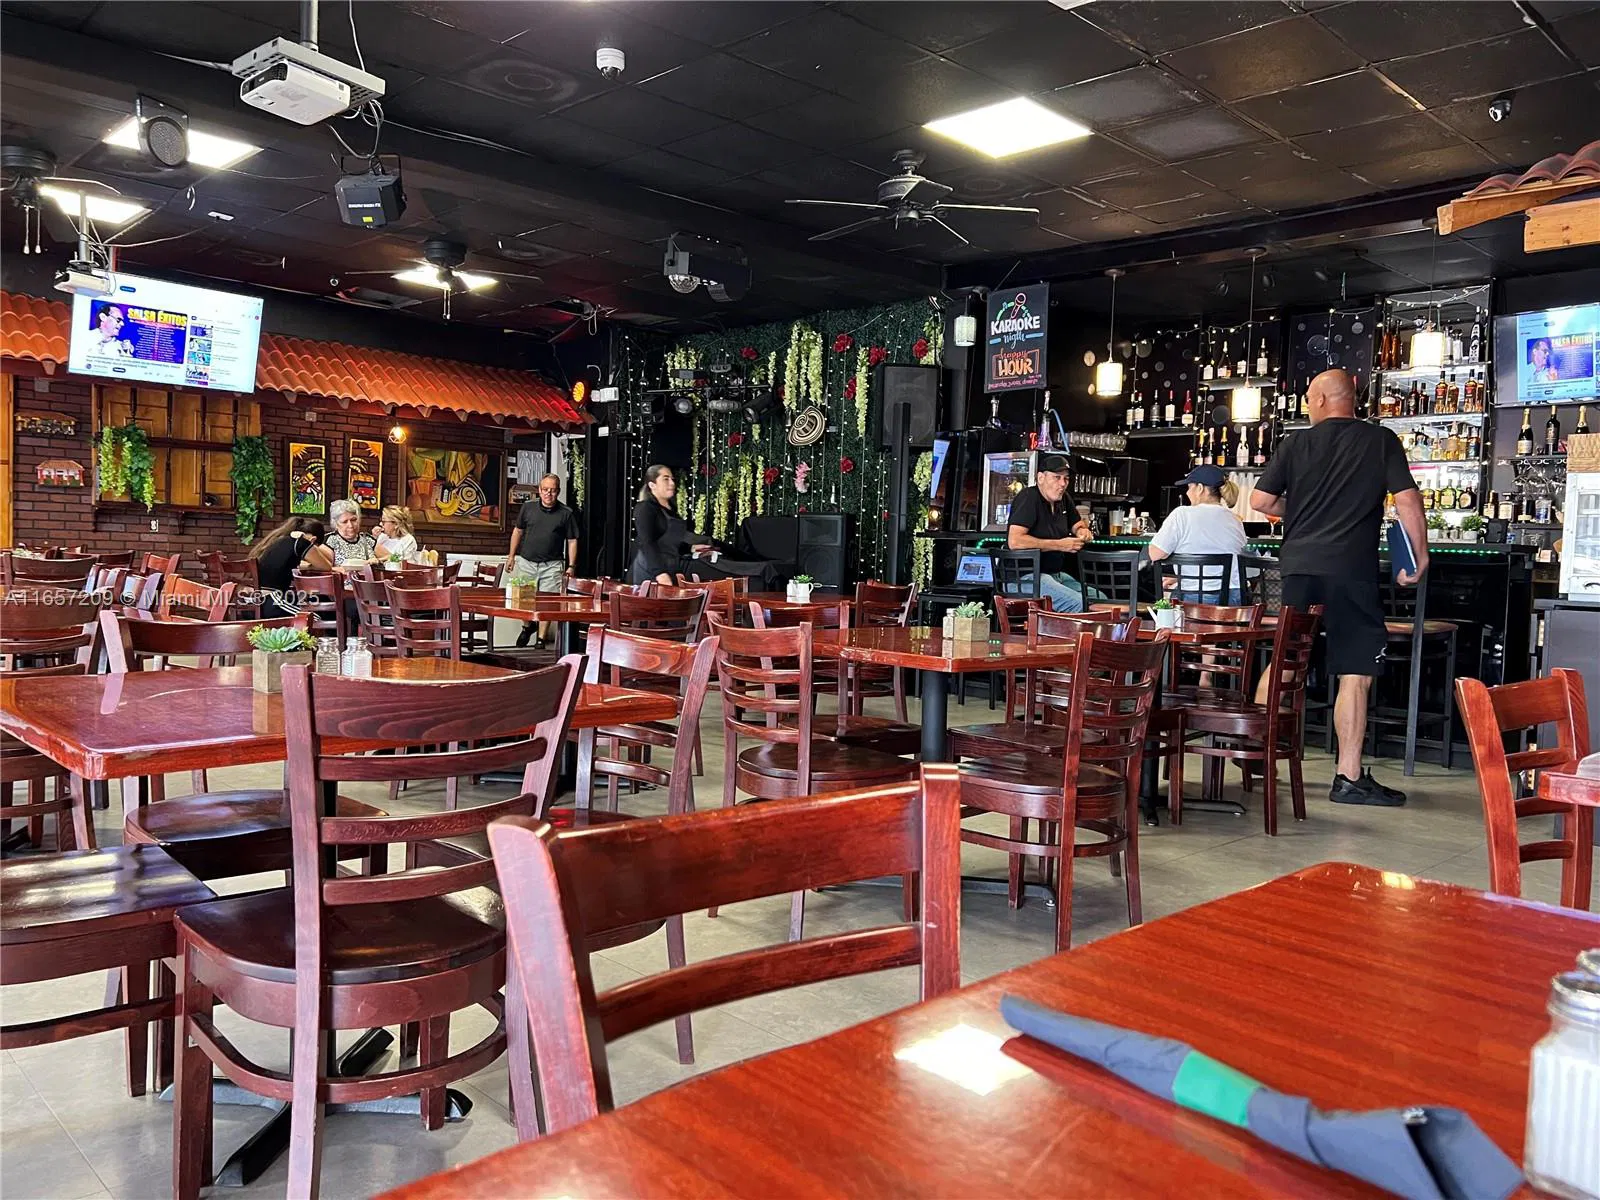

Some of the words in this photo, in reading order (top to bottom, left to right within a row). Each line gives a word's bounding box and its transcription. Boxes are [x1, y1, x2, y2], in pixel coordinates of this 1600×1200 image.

[127, 308, 156, 322] SALSA
[990, 316, 1041, 336] KARAOKE
[998, 358, 1034, 377] HOUR
